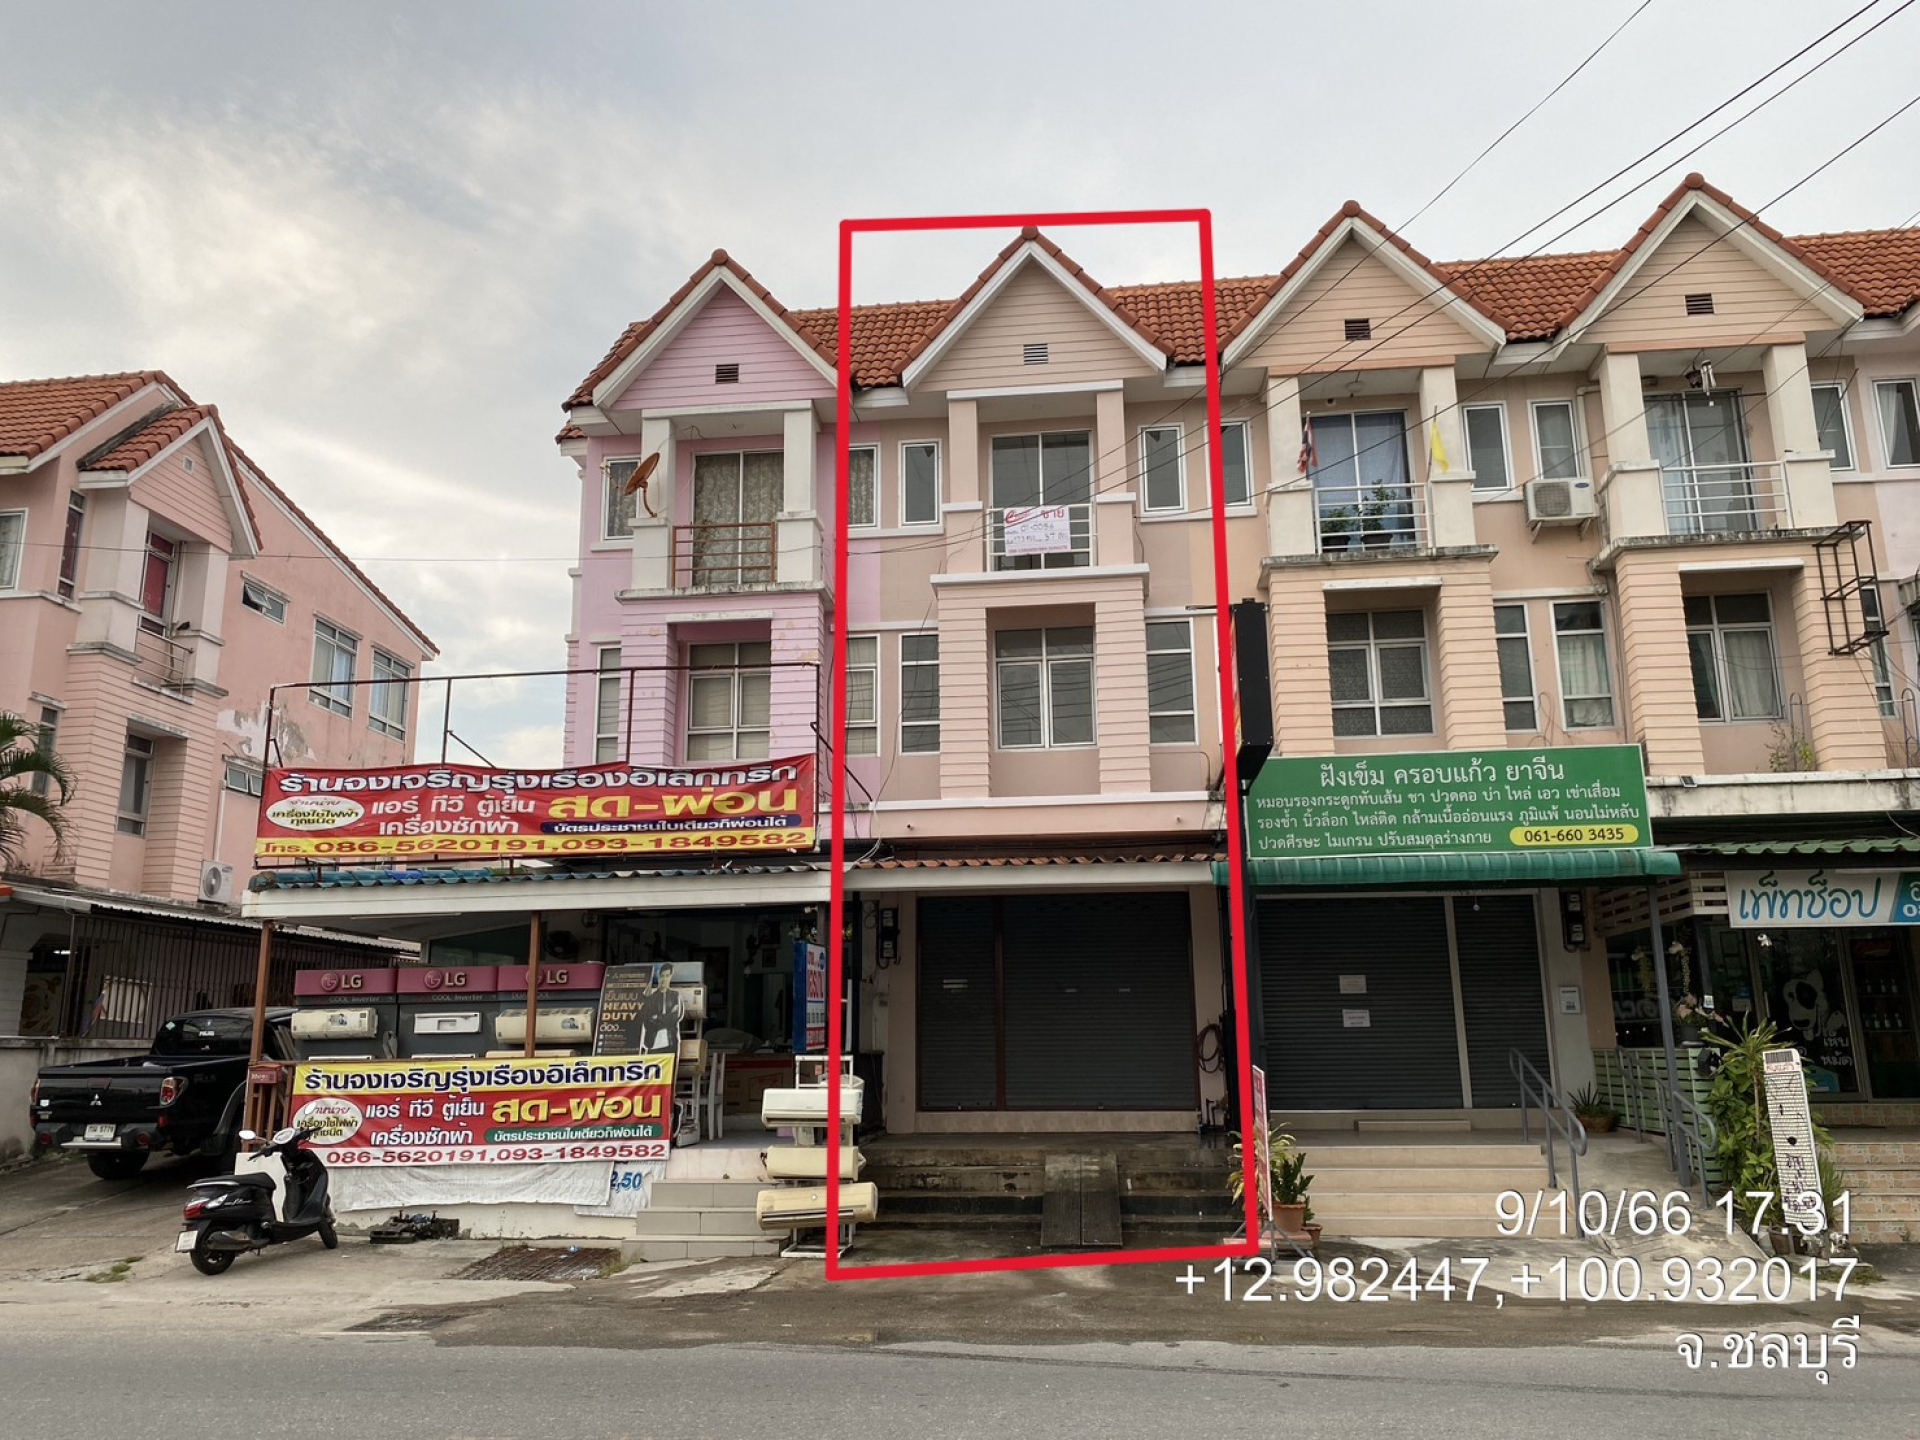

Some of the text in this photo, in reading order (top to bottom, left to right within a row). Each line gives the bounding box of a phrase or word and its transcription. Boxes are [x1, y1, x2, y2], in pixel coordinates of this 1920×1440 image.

[1320, 756, 1565, 788] ฝังเข็ม ครอบแก้ว ยาจีน
[548, 786, 798, 819] สด-ผ่อน
[1256, 789, 1403, 810] หมอนรองกระดูกทับเส้น
[1430, 788, 1477, 804] ปวดคอ
[1482, 787, 1501, 801] บ่า
[1505, 785, 1532, 801] ไหล่
[1537, 787, 1560, 800] เอว
[1566, 779, 1621, 799] เข่าเสื่อม
[371, 795, 536, 818] แอร์ ทีวี ตู้เย็น
[1302, 808, 1348, 828] นิ้วล็อก
[1352, 810, 1397, 826] ไหล่ติด
[1402, 803, 1513, 825] กล้ามเนื้ออ่อนแรง
[1518, 804, 1559, 826] ภูมิแพ้
[1564, 802, 1640, 821] นอนไม่หลับ
[378, 815, 519, 836] เครื่องซักผ้า
[1524, 827, 1625, 842] 061-660 3435
[1257, 829, 1492, 849] ปวดศีรษะ ไมเกรน ปรับสมดุลร่างกาย
[341, 974, 363, 989] LG
[444, 972, 467, 988] LG
[546, 969, 568, 985] LG
[601, 1012, 637, 1021] DUTY
[603, 1002, 645, 1011] HEAVY
[305, 1061, 661, 1092] ร้านจงเจริญรุ่งเรืองอิเล็กทริก
[366, 1094, 485, 1121] แอร์ ทีวี ตู้เย็น
[491, 1091, 662, 1123] สด-ผ่อน
[370, 1122, 473, 1145] เครื่องซักผ้า
[326, 1144, 666, 1164] 086-5620191,093-1849582
